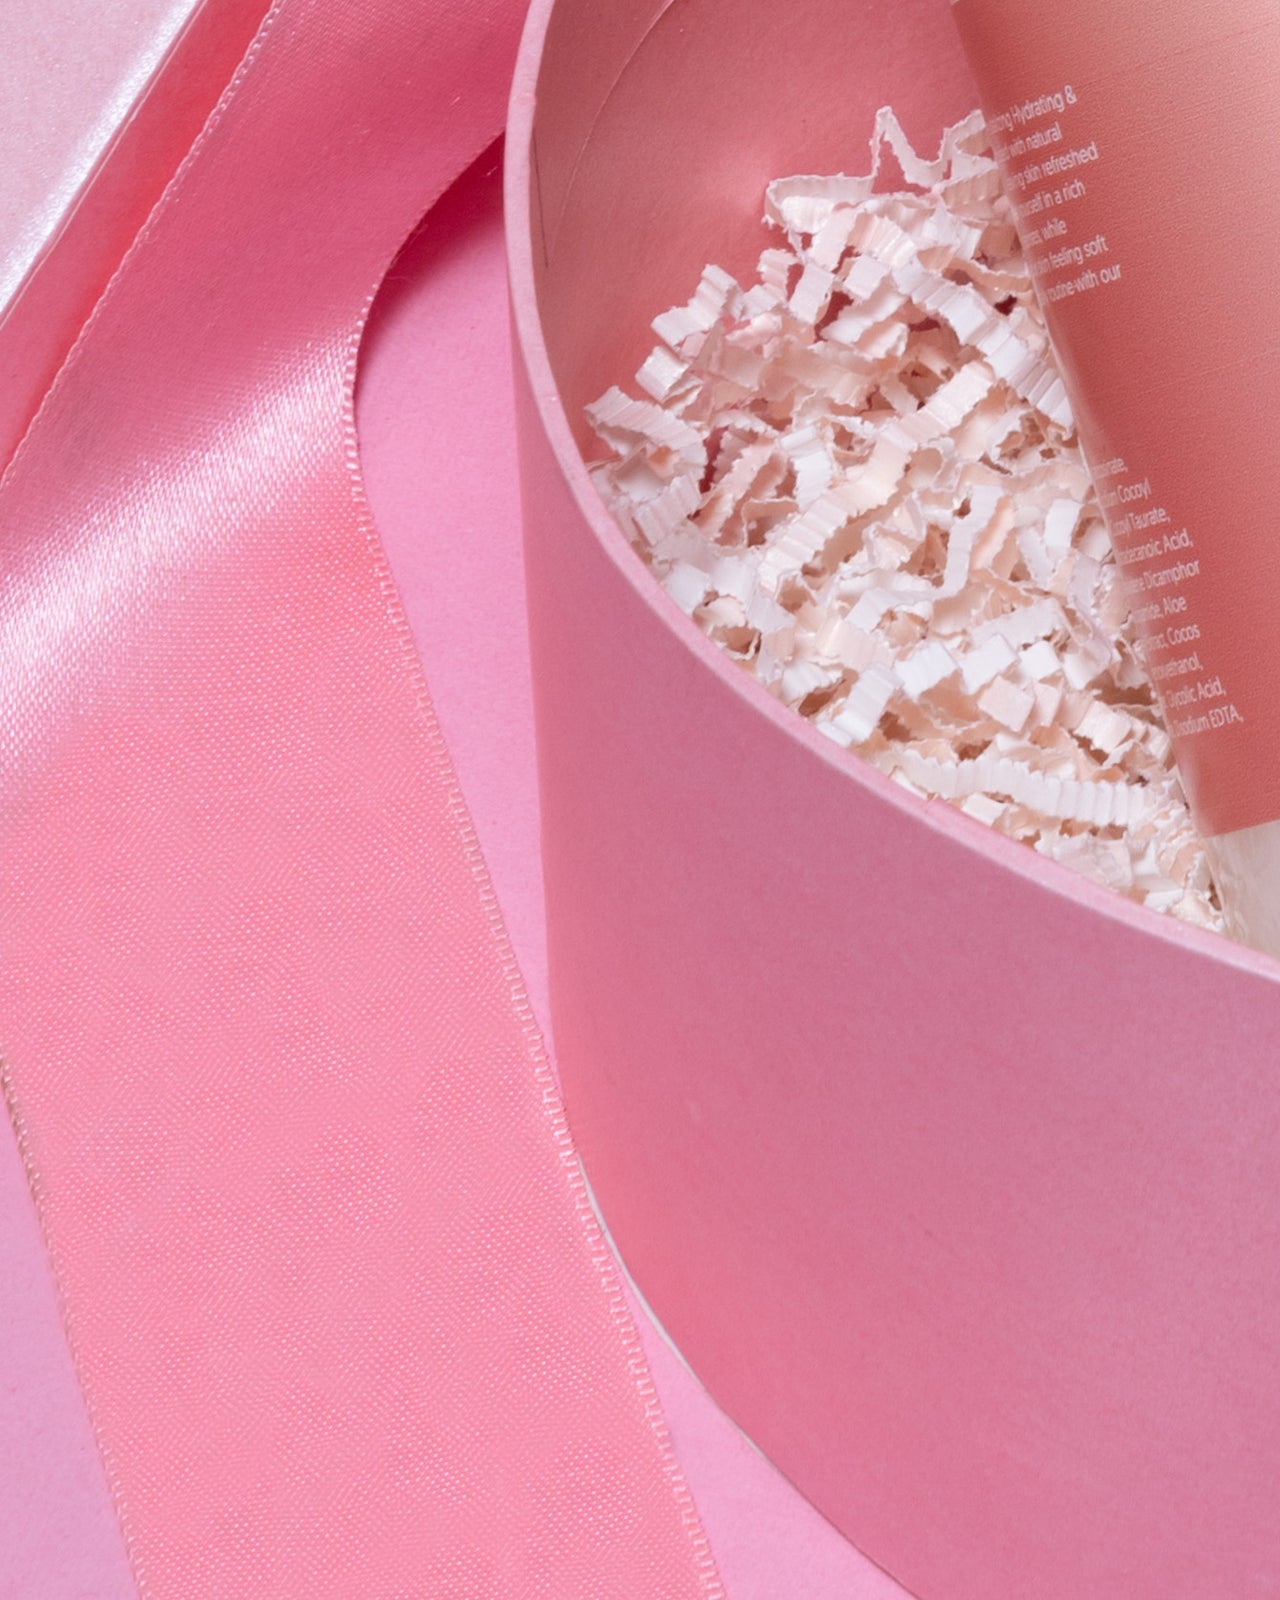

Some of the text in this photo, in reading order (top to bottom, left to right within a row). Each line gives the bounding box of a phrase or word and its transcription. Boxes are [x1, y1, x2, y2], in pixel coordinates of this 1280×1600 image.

[1064, 84, 1077, 104] &
[1083, 234, 1109, 257] soft
[1100, 263, 1120, 284] our
